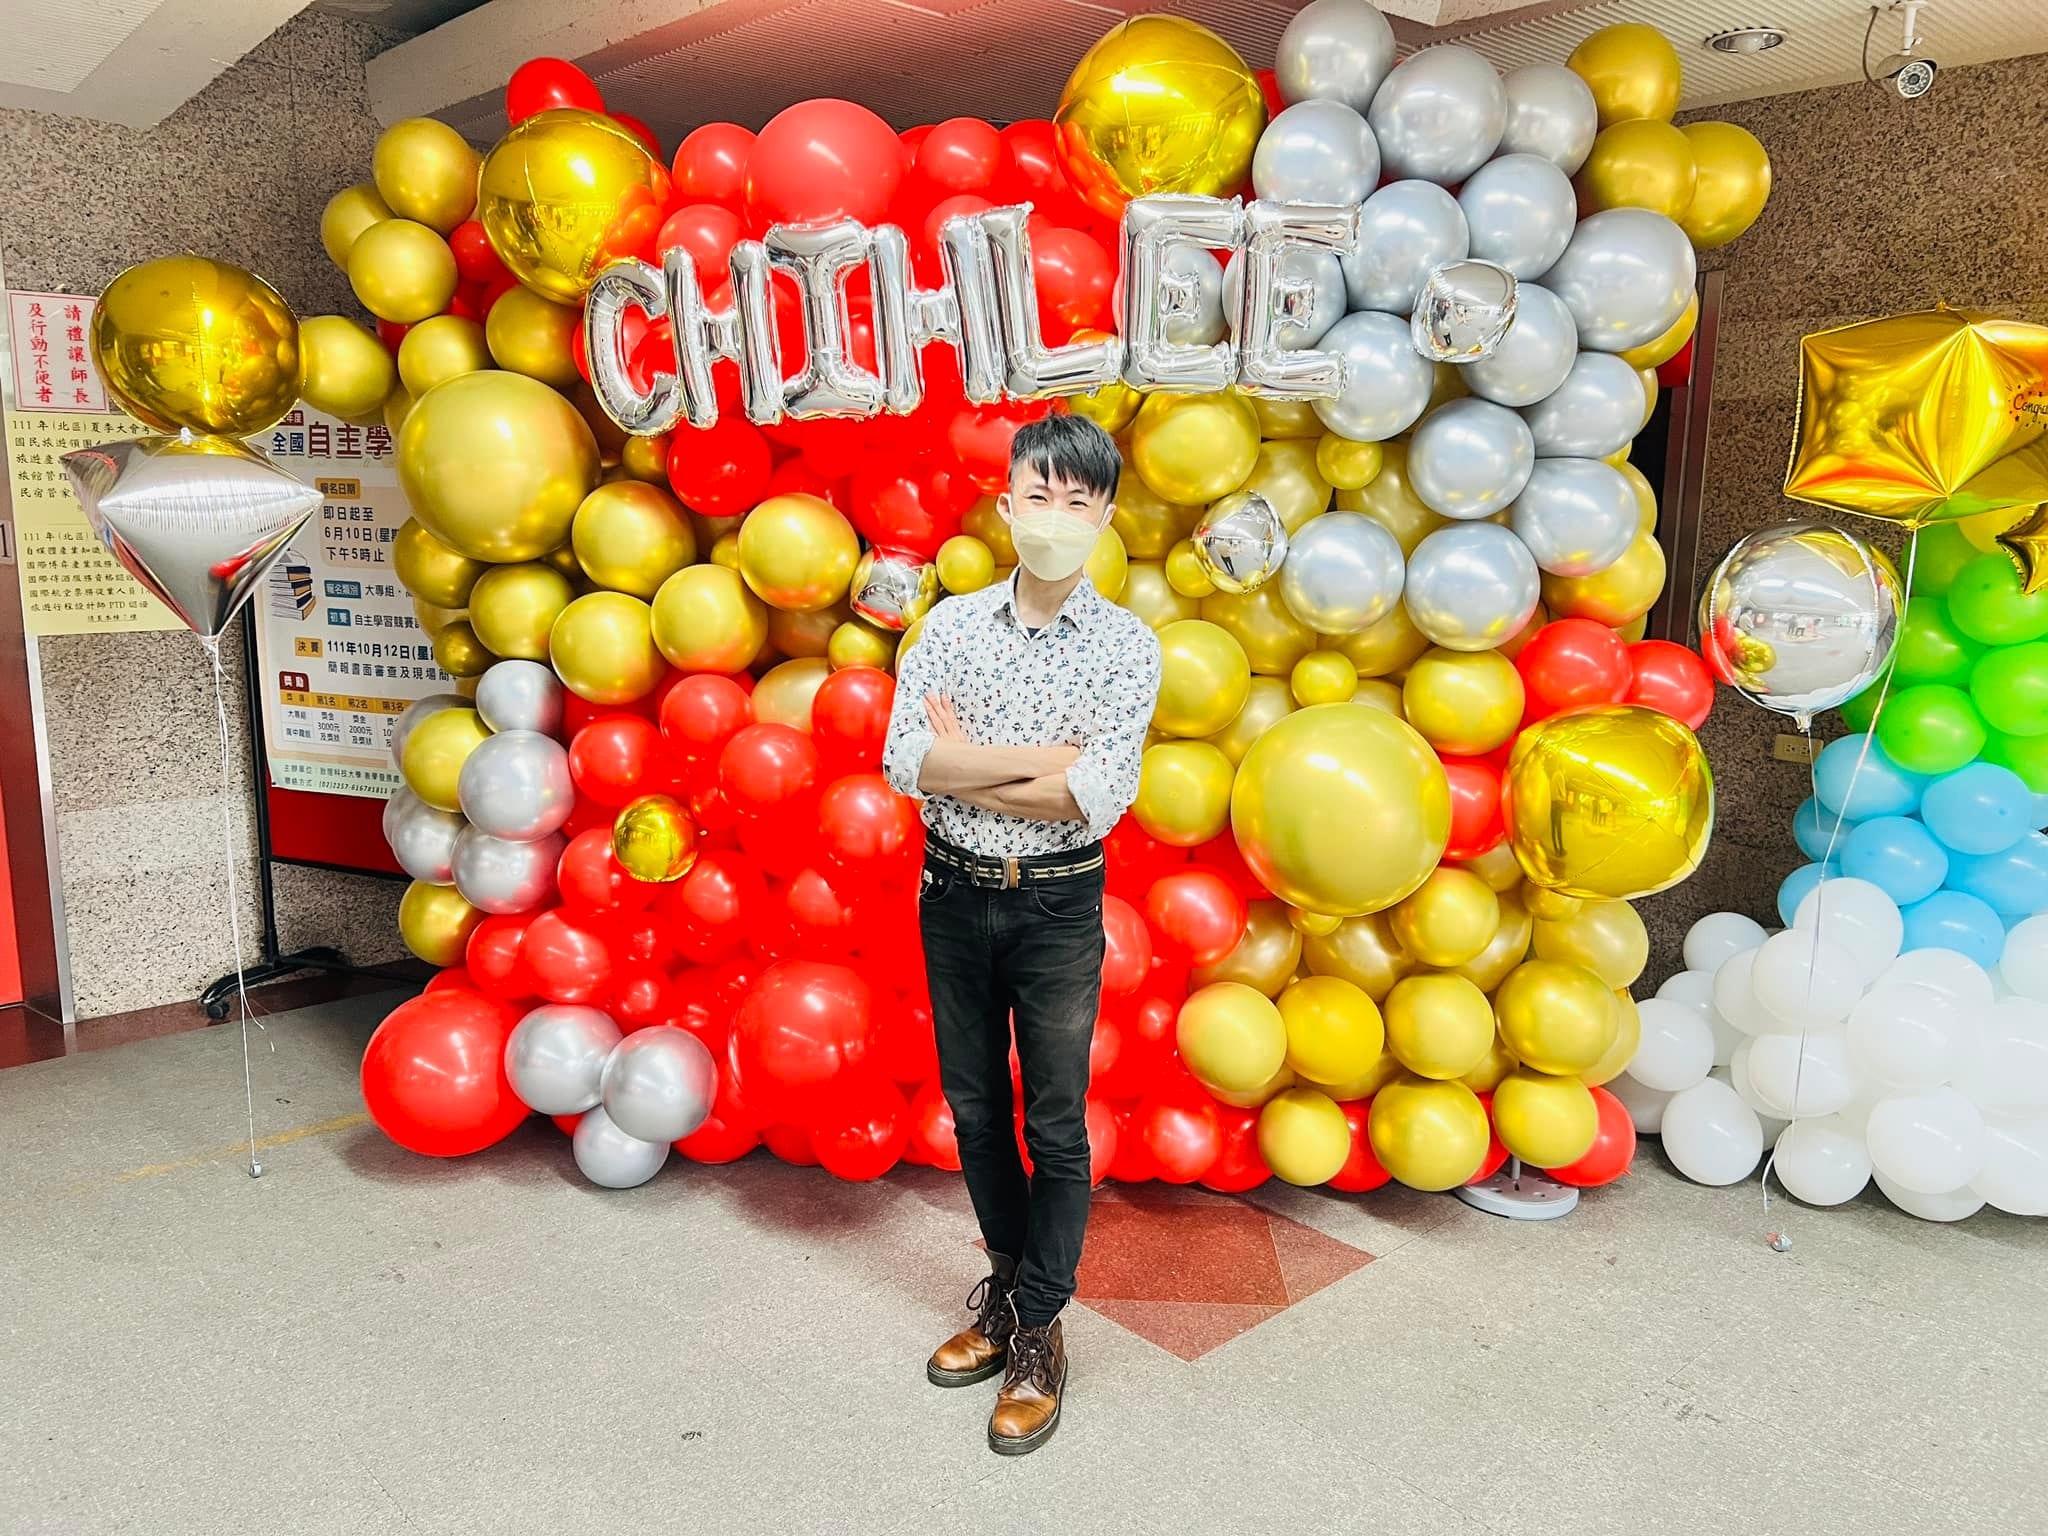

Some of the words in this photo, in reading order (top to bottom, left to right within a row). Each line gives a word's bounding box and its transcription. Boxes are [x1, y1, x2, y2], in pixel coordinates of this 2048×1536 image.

[583, 193, 1362, 437] CHIHLEE
[28, 302, 54, 403] 及行動不便者
[64, 304, 90, 403] 請禮讓師長
[272, 432, 304, 455] 全國
[16, 453, 61, 465] 旅遊產
[323, 505, 374, 521] 即日起至
[325, 546, 385, 562] 下午5時止
[327, 640, 434, 661] 111年10月12日(星
